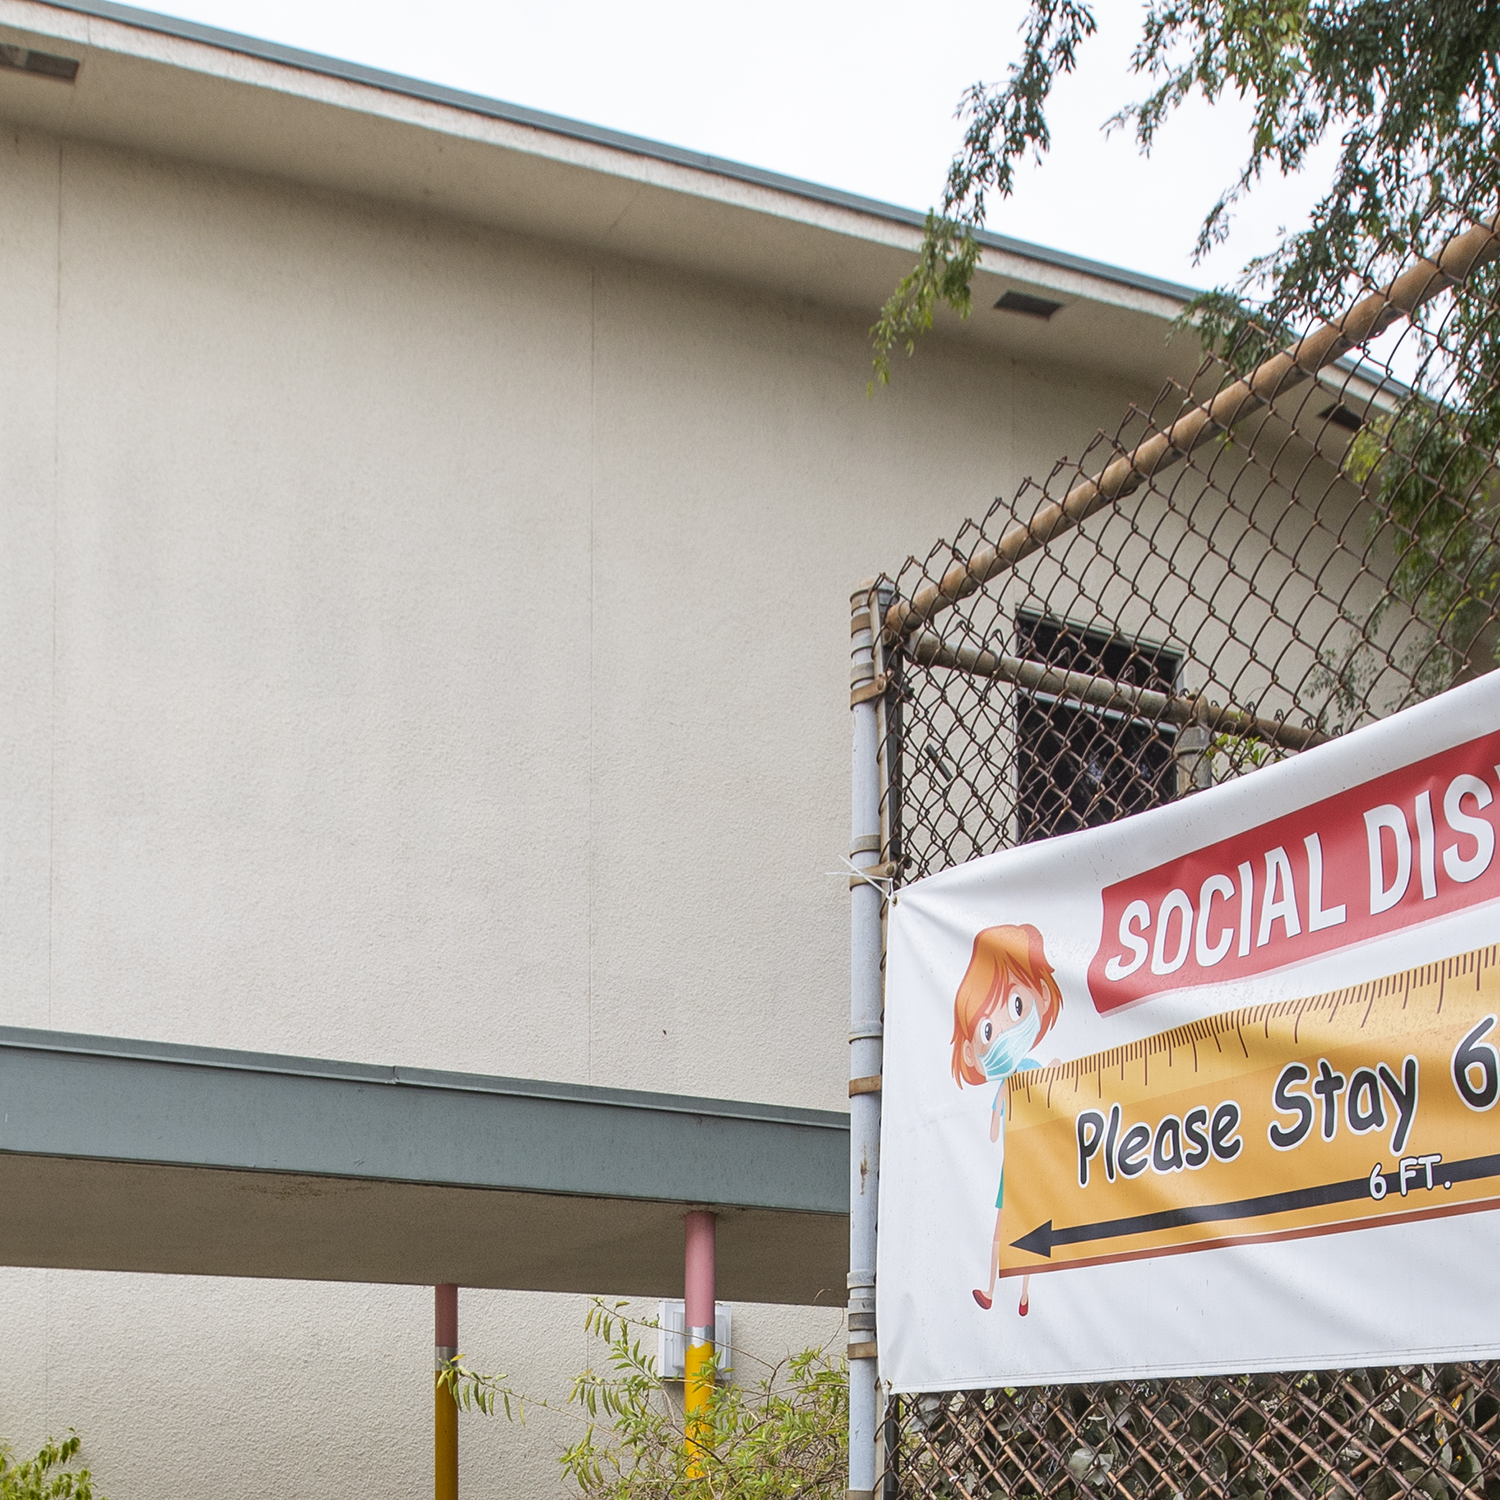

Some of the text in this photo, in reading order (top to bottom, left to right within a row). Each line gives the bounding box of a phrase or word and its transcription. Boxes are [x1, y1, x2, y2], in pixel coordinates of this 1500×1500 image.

[1104, 832, 1348, 984] SOCIAL
[1077, 1102, 1243, 1187] Please
[1269, 1055, 1419, 1155] Stay
[1369, 1153, 1453, 1201] 6 FT.
